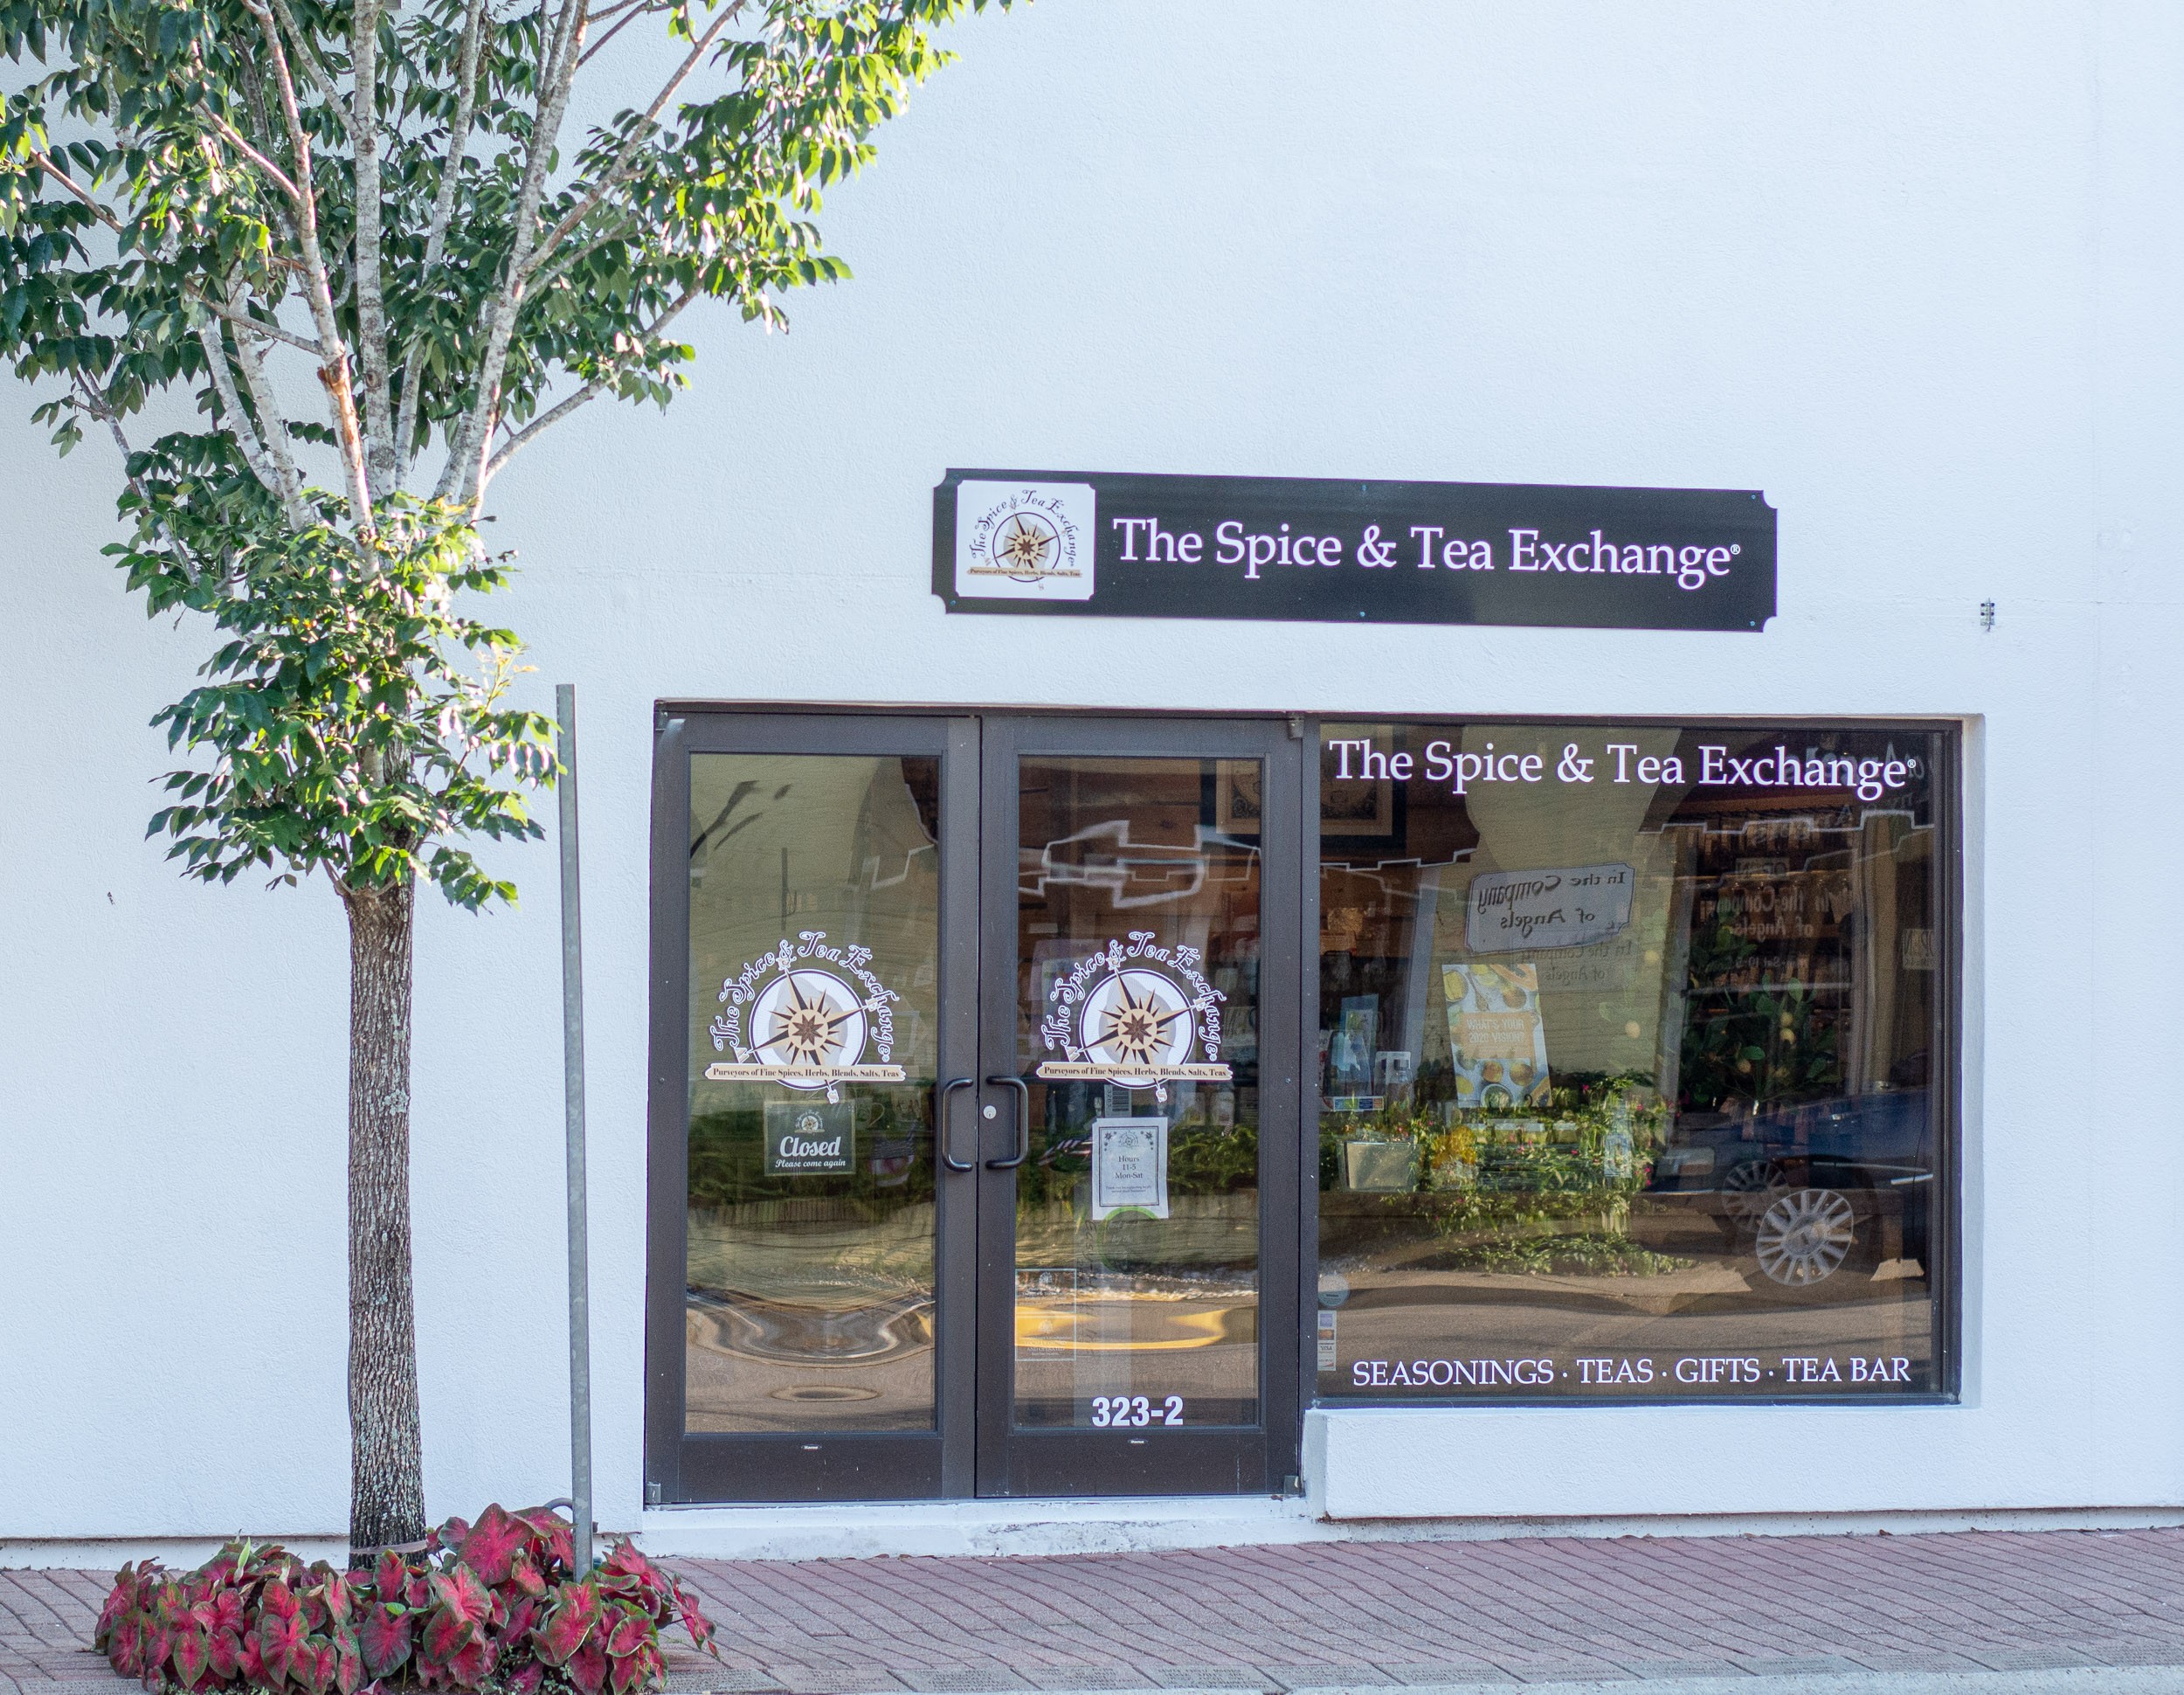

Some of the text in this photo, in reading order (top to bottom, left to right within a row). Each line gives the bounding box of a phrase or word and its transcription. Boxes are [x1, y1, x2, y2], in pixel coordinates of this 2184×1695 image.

[1020, 489, 1046, 507] Tea
[975, 501, 1007, 532] Spice
[969, 533, 987, 558] The
[1113, 517, 1202, 563] The
[1215, 520, 1342, 578] Spice
[1357, 524, 1397, 568] &
[1410, 525, 1494, 572] Tea
[1329, 740, 1413, 780] The
[1426, 741, 1543, 794] Spice
[1557, 744, 1594, 783] &
[1607, 744, 1685, 785] Tea
[778, 939, 797, 963] &
[797, 931, 842, 963] Tea
[1106, 939, 1126, 963] &
[1126, 931, 1171, 963] Tea
[719, 951, 776, 1005] Spice
[1051, 950, 1105, 1004] Spice
[709, 1002, 740, 1051] The
[1041, 1005, 1072, 1051] The
[1469, 1032, 1489, 1043] 2020
[1502, 1019, 1525, 1030] YOUR
[713, 1068, 750, 1078] Purveyors
[751, 1068, 761, 1076] of
[760, 1068, 777, 1077] Fine
[778, 1069, 803, 1078] Spices,
[805, 1069, 829, 1077] Herbs,
[831, 1069, 858, 1078] Blends,
[860, 1069, 880, 1078] Salts,
[1044, 1067, 1080, 1076] Purveyors
[1082, 1066, 1090, 1076] of
[1090, 1067, 1106, 1076] Fine
[1108, 1068, 1133, 1077] Spices,
[1135, 1068, 1158, 1076] Herbs,
[1160, 1068, 1186, 1077] Blends,
[1188, 1068, 1208, 1077] Salts,
[779, 1136, 841, 1157] Closed
[775, 1159, 801, 1168] Please
[824, 1159, 846, 1168] again
[1352, 1357, 1911, 1387] SEASONINGS TEAS GIFTS TEA BAR
[1092, 1395, 1184, 1427] 323-2
